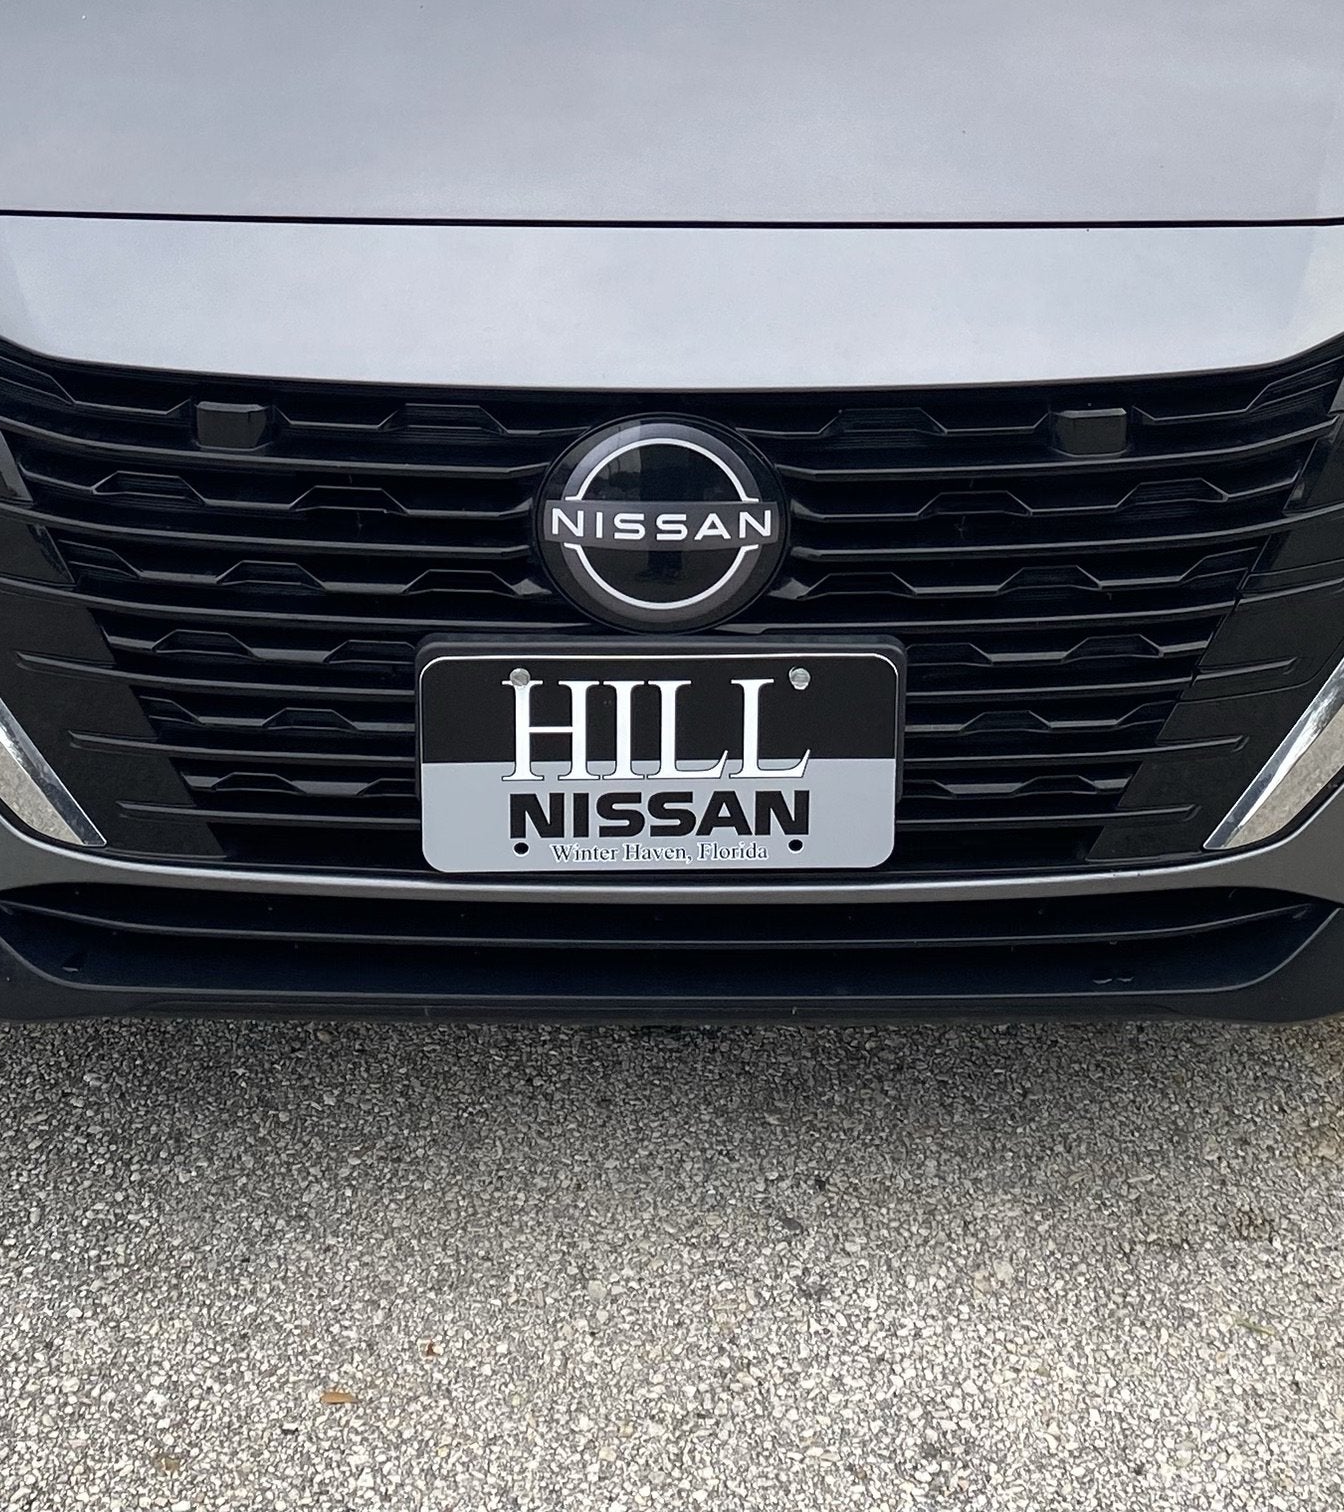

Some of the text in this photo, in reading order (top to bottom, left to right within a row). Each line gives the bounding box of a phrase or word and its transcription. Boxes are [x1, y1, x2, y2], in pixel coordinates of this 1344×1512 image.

[552, 507, 772, 541] NISSAN
[502, 678, 811, 781] HILL
[509, 789, 810, 839] NISSAN
[552, 841, 769, 864] Winter Haven, Florida
